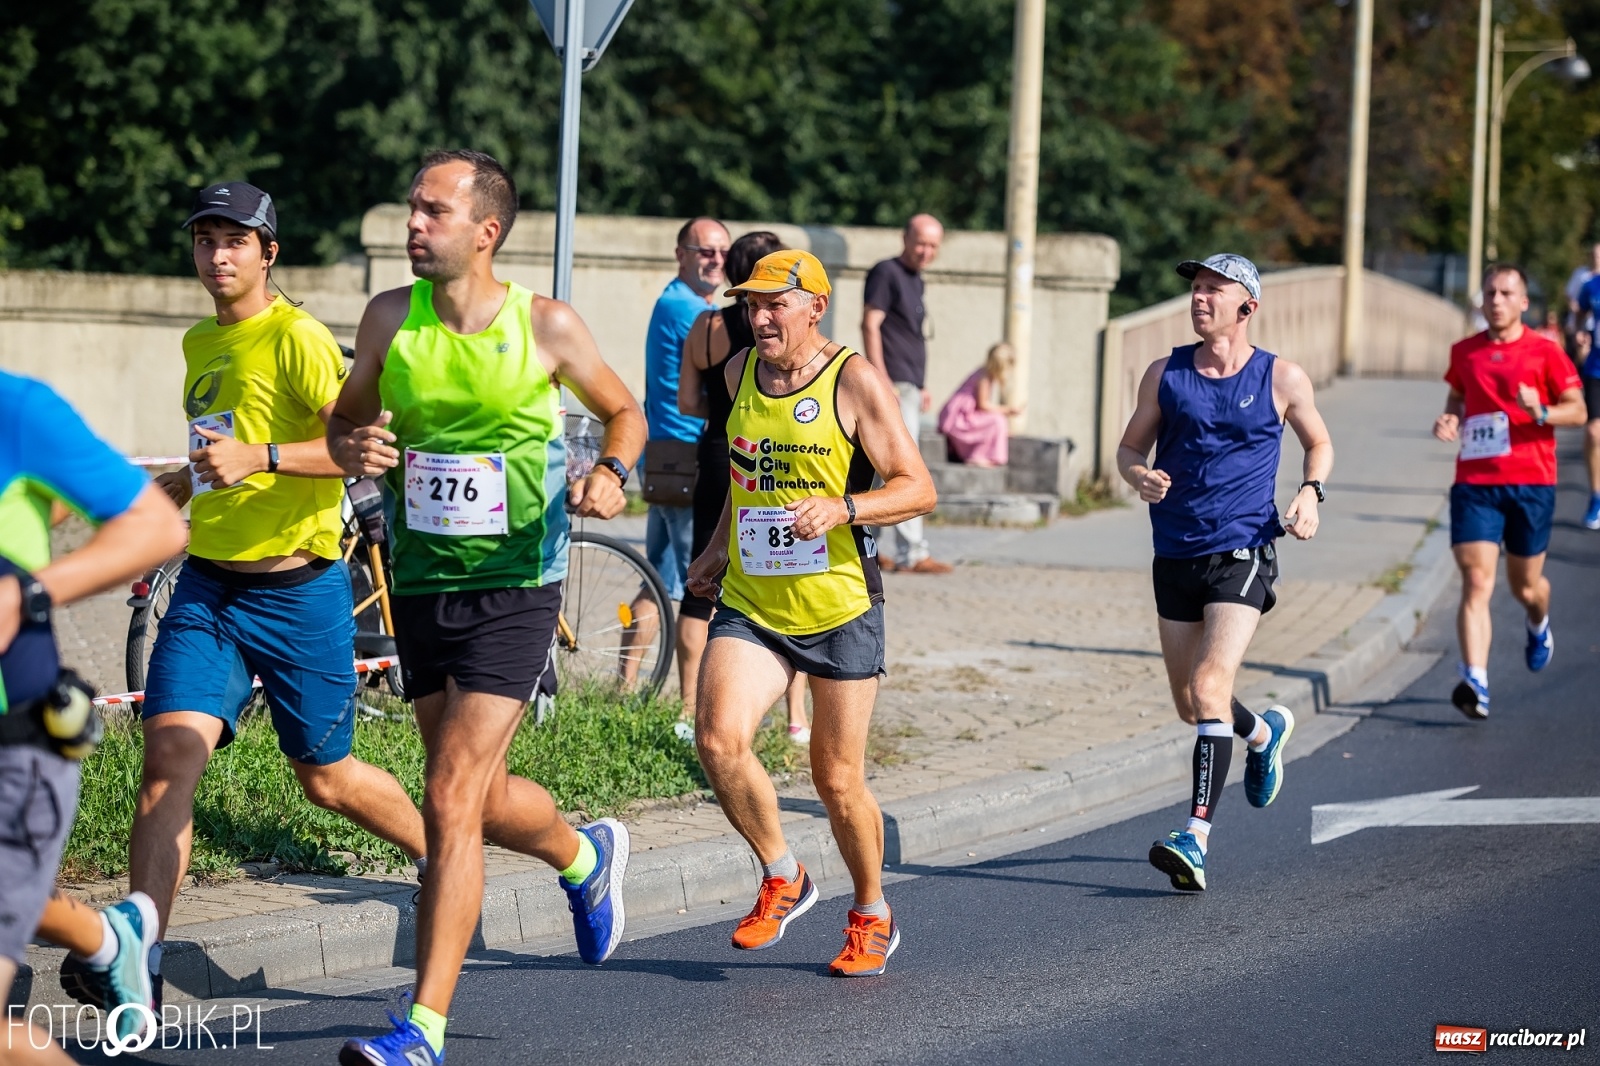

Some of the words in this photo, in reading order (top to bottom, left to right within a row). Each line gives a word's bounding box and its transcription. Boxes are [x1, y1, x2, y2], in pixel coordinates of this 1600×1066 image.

[759, 437, 832, 457] Gloucester
[759, 456, 791, 474] City
[429, 476, 478, 502] 276
[759, 474, 826, 492] Marathon
[768, 526, 795, 548] 83
